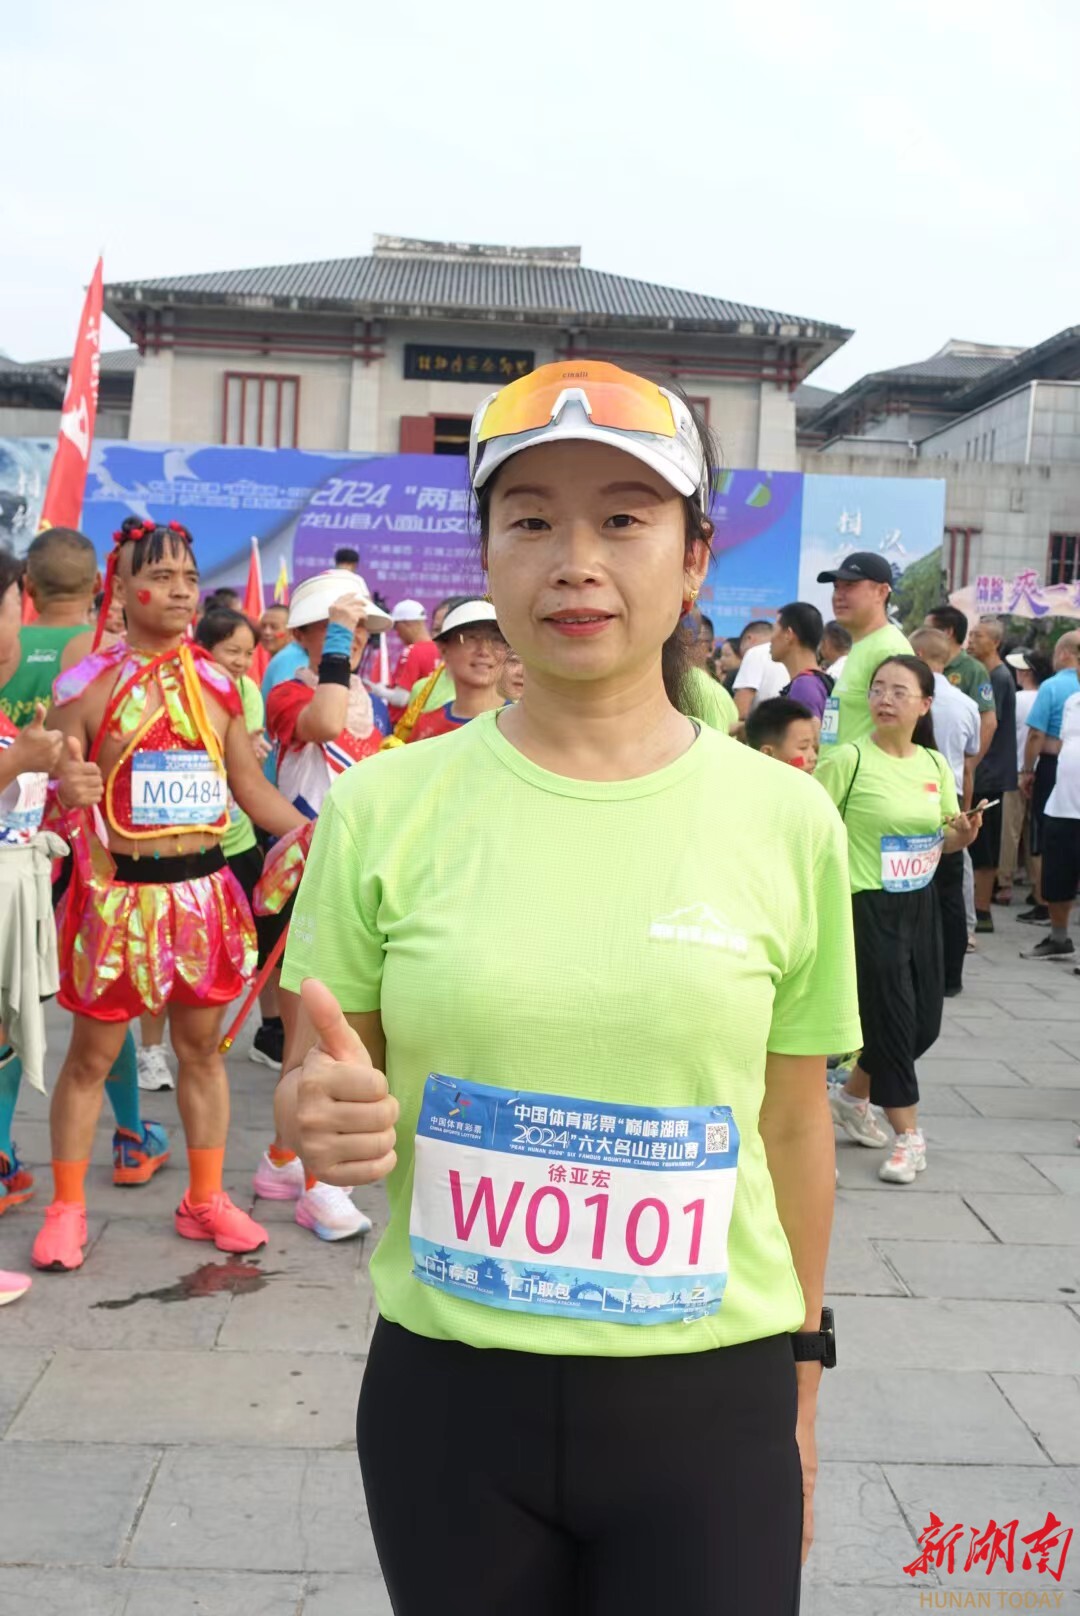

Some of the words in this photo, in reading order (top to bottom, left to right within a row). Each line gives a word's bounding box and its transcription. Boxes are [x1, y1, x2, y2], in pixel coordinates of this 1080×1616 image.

[310, 477, 392, 509] 2024
[143, 780, 222, 805] M0484
[430, 1115, 483, 1134] 中国体育彩票
[578, 1153, 601, 1161] FAMOUS
[602, 1156, 632, 1164] MOUNTAIN
[547, 1164, 611, 1189] 徐亚宏
[448, 1169, 706, 1267] W0101
[537, 1280, 570, 1300] 取包
